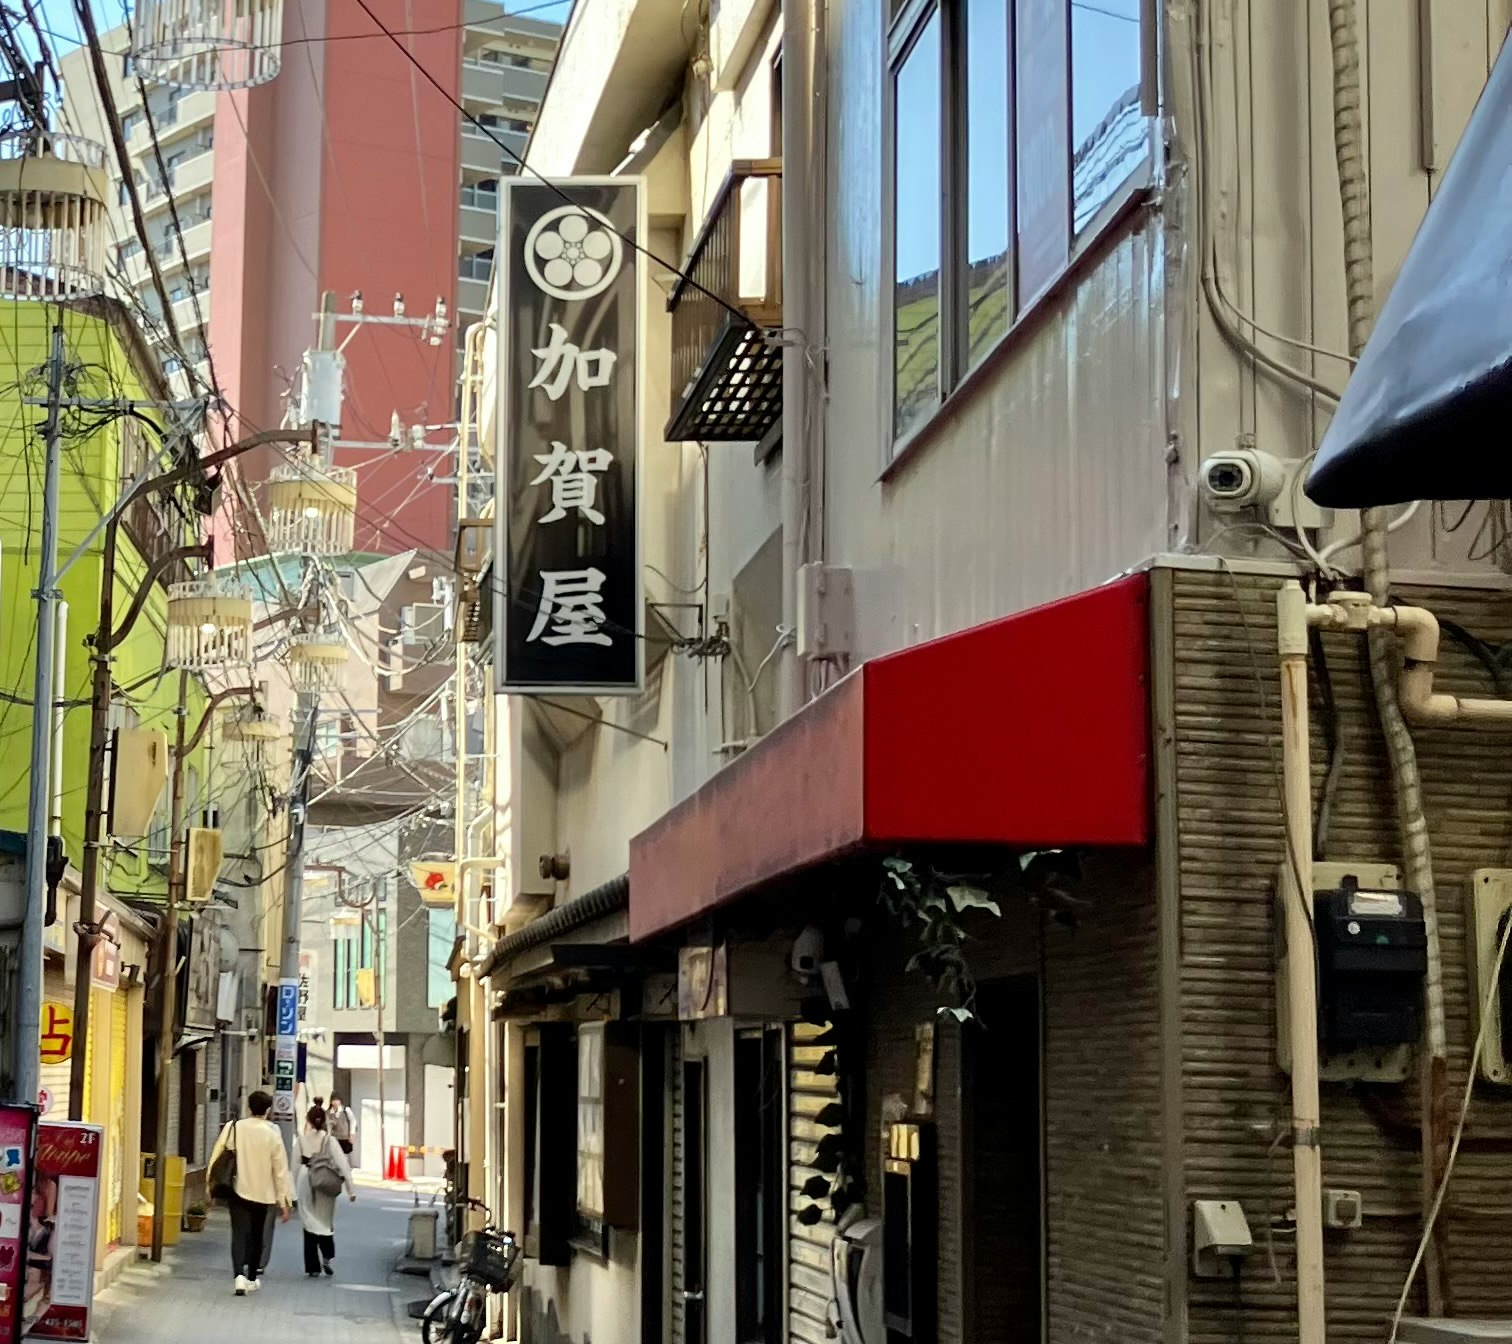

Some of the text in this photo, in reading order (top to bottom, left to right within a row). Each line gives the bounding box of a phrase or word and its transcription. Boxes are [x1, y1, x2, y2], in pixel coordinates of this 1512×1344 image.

[526, 323, 618, 647] 加賀屋
[40, 1006, 71, 1055] 占
